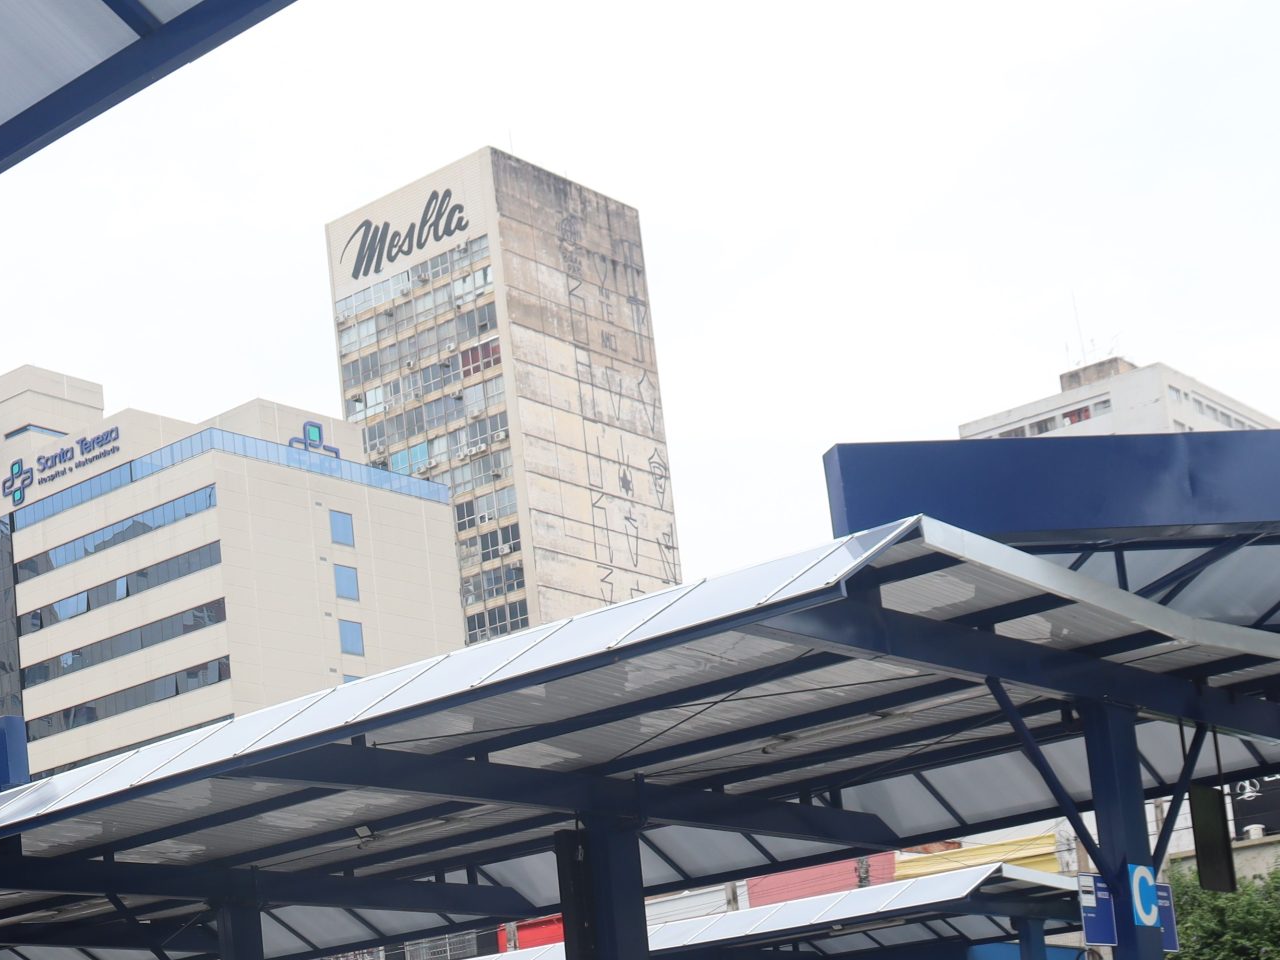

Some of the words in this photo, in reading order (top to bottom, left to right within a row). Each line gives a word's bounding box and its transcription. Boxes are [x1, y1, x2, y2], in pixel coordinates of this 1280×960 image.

[340, 188, 469, 280] Mesbla
[36, 446, 74, 473] Santa
[75, 426, 120, 456] Tereza
[37, 466, 67, 485] Hospital
[74, 445, 120, 469] Maternidade
[1132, 865, 1159, 926] C
